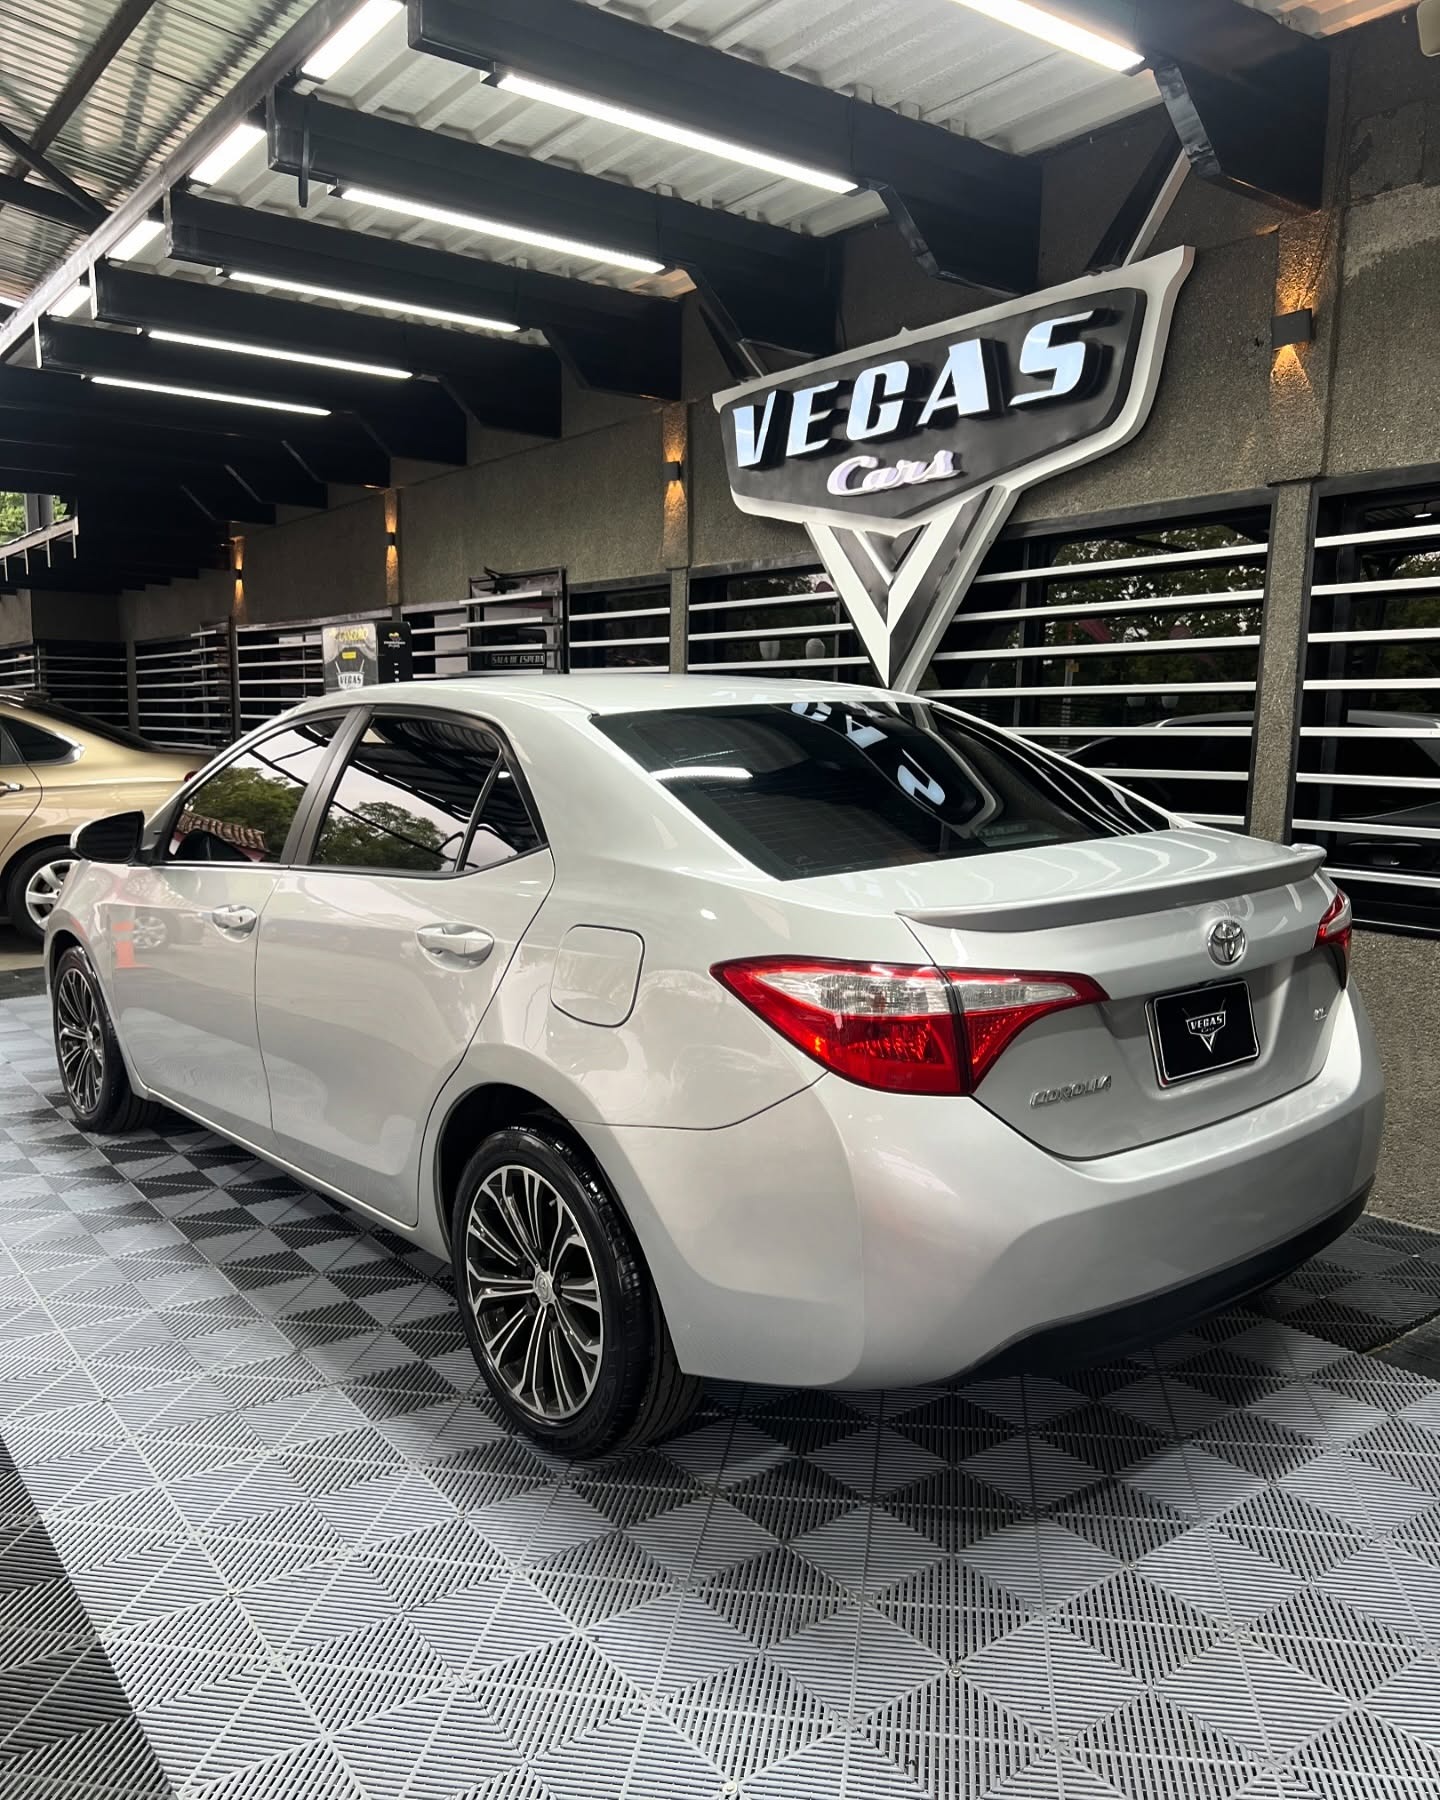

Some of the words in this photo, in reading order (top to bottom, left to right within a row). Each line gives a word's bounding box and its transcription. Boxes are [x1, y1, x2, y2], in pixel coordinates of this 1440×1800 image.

[732, 310, 1094, 468] VEGAS
[827, 449, 961, 496] Cars
[1190, 1014, 1223, 1030] VEGAS
[1029, 1075, 1112, 1107] COROLLA
